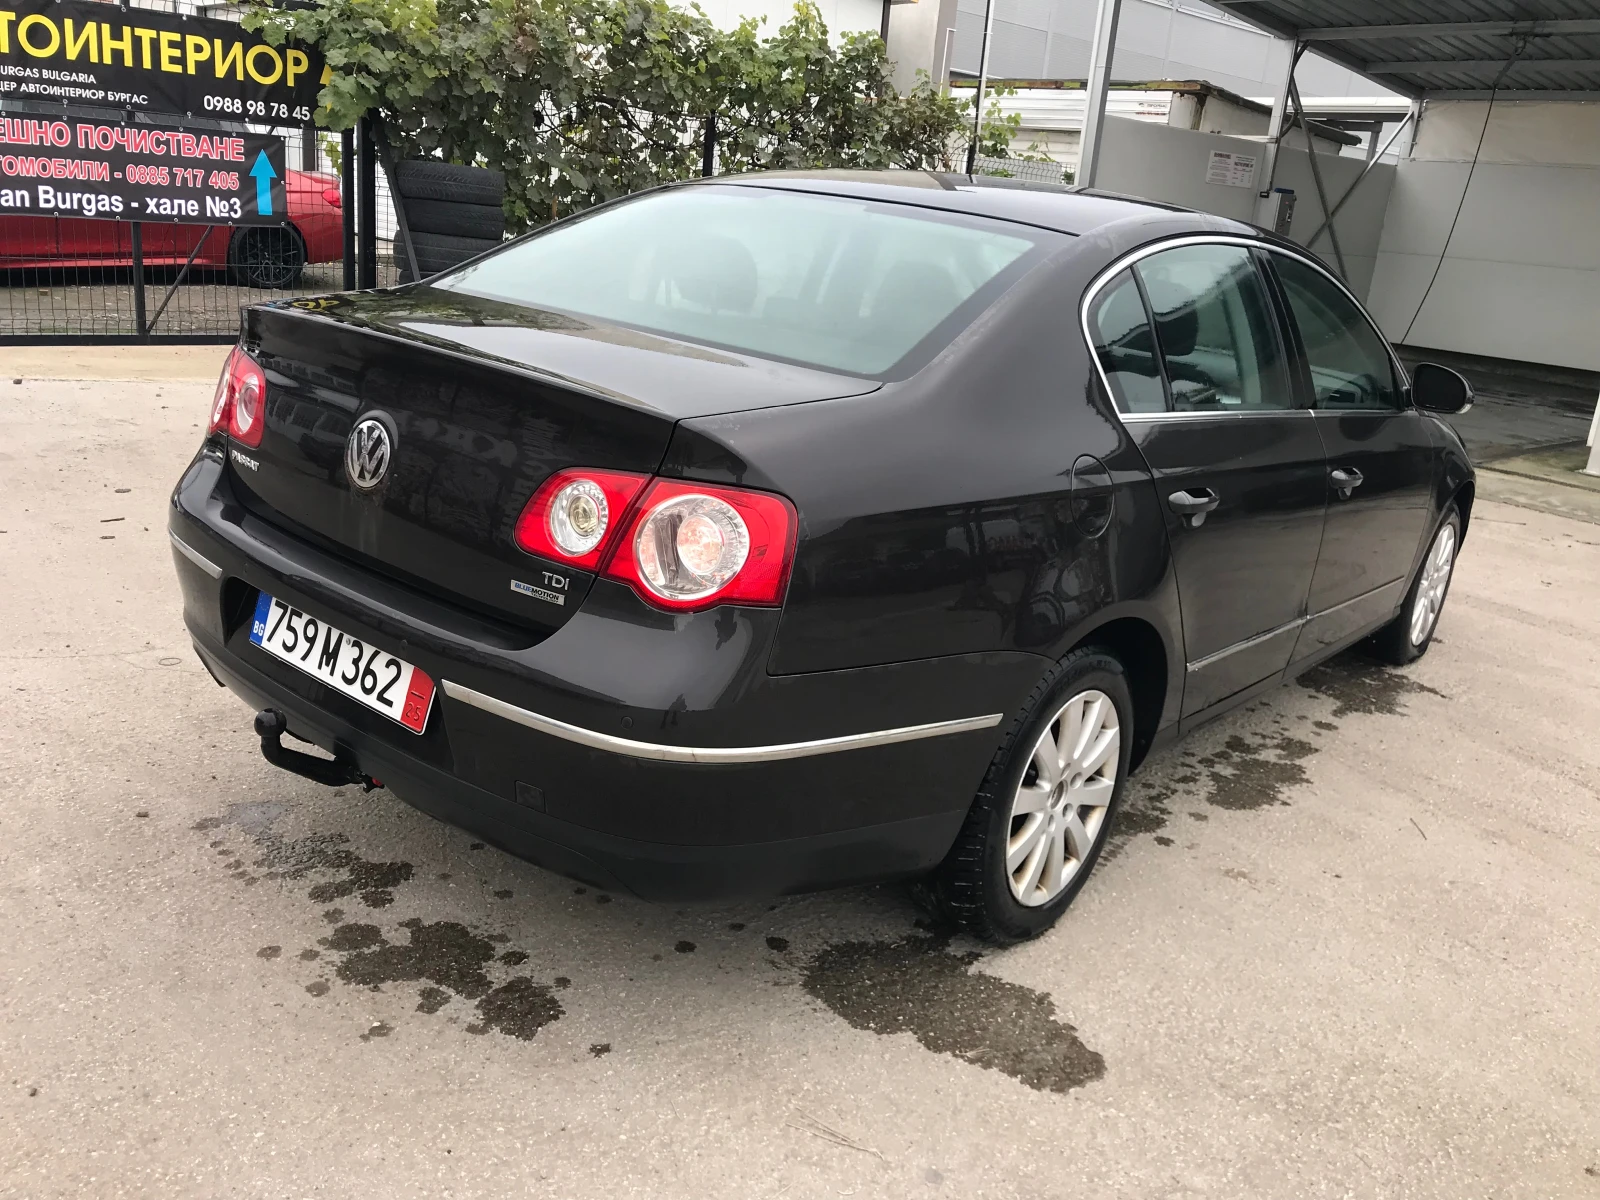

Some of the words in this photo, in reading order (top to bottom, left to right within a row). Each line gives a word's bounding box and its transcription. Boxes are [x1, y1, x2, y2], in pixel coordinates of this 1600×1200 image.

[0, 65, 39, 78] URGAS
[42, 69, 97, 84] BULGARIA
[20, 83, 105, 100] АВТОИНТЕРИОР
[107, 91, 149, 105] БУРГАС
[203, 95, 243, 114] 0988
[246, 100, 266, 116] 98
[270, 102, 289, 119] 78
[292, 106, 311, 121] 45
[77, 123, 245, 161] ПОЧИСТВАНЕ
[0, 154, 110, 181] ОМОБИЛИ
[126, 164, 170, 186] 0885
[173, 167, 204, 188] 717
[209, 170, 240, 190] 405
[0, 188, 30, 208] an
[37, 185, 124, 216] Burgas
[145, 196, 200, 216] хале
[205, 195, 242, 219] №3
[514, 582, 560, 601] BLUEMOTION
[541, 571, 570, 591] TDI
[252, 620, 265, 637] BG
